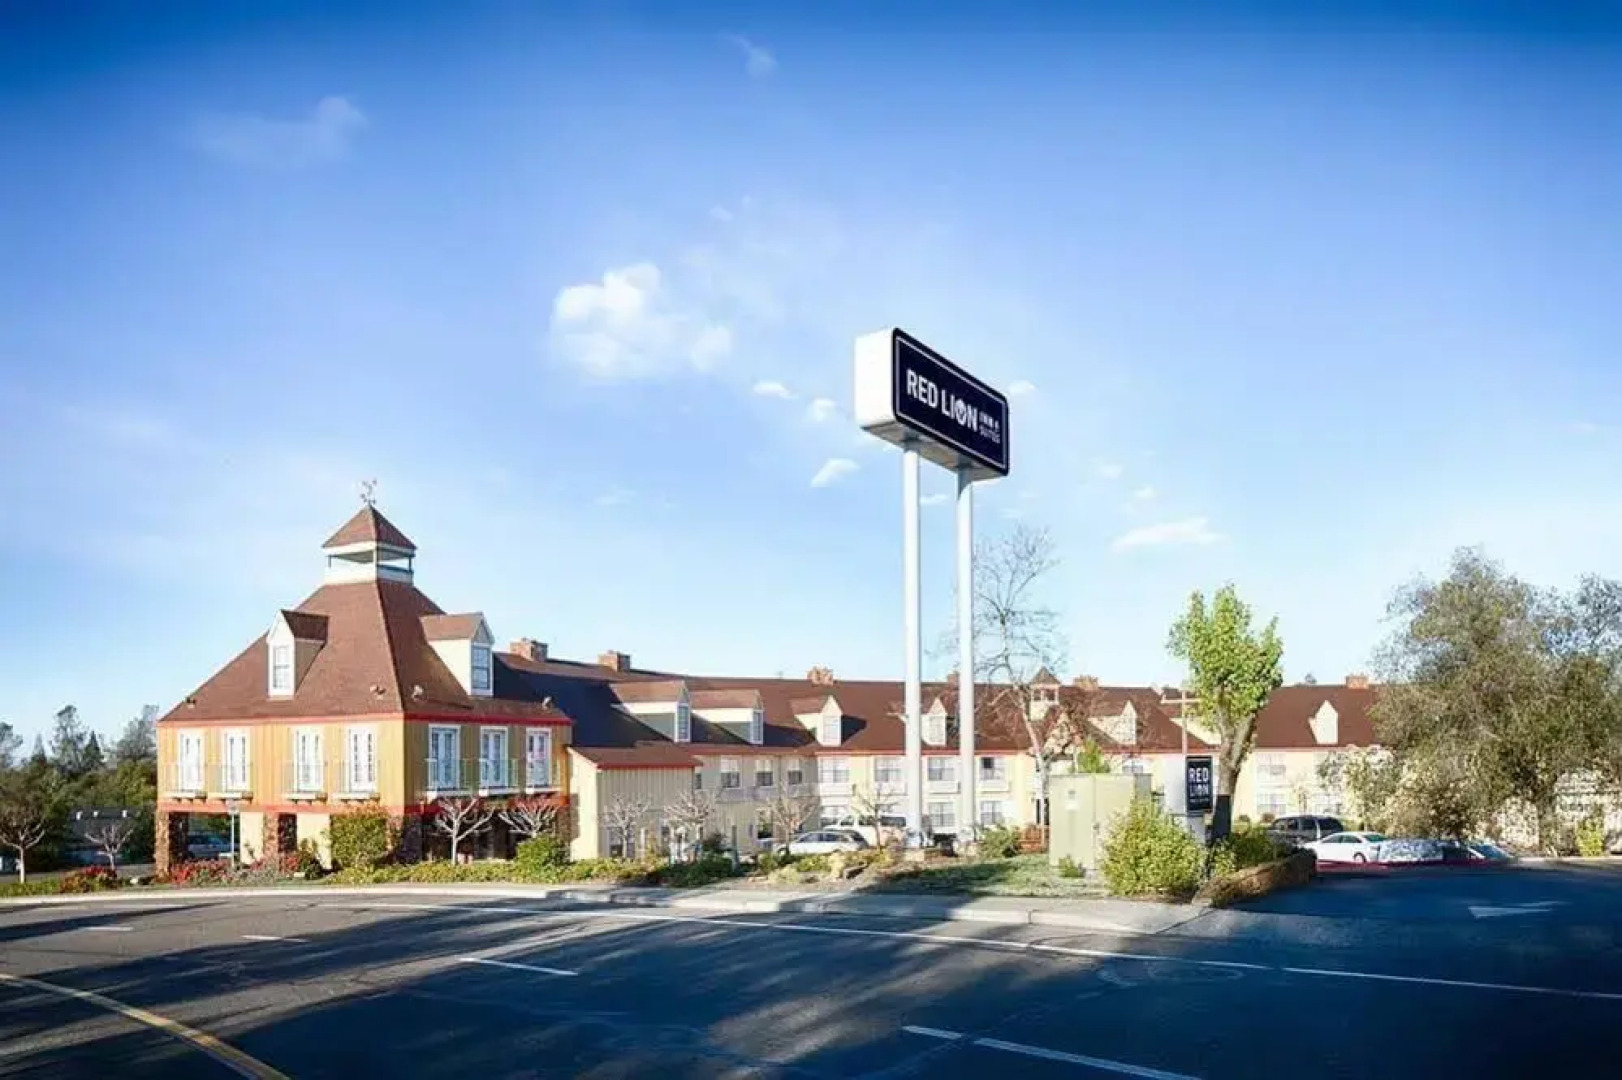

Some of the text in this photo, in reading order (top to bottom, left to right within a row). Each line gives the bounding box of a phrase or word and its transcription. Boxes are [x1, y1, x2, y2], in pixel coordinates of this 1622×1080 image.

[906, 369, 938, 409] RED
[941, 389, 978, 432] LION
[1189, 767, 1209, 782] RED
